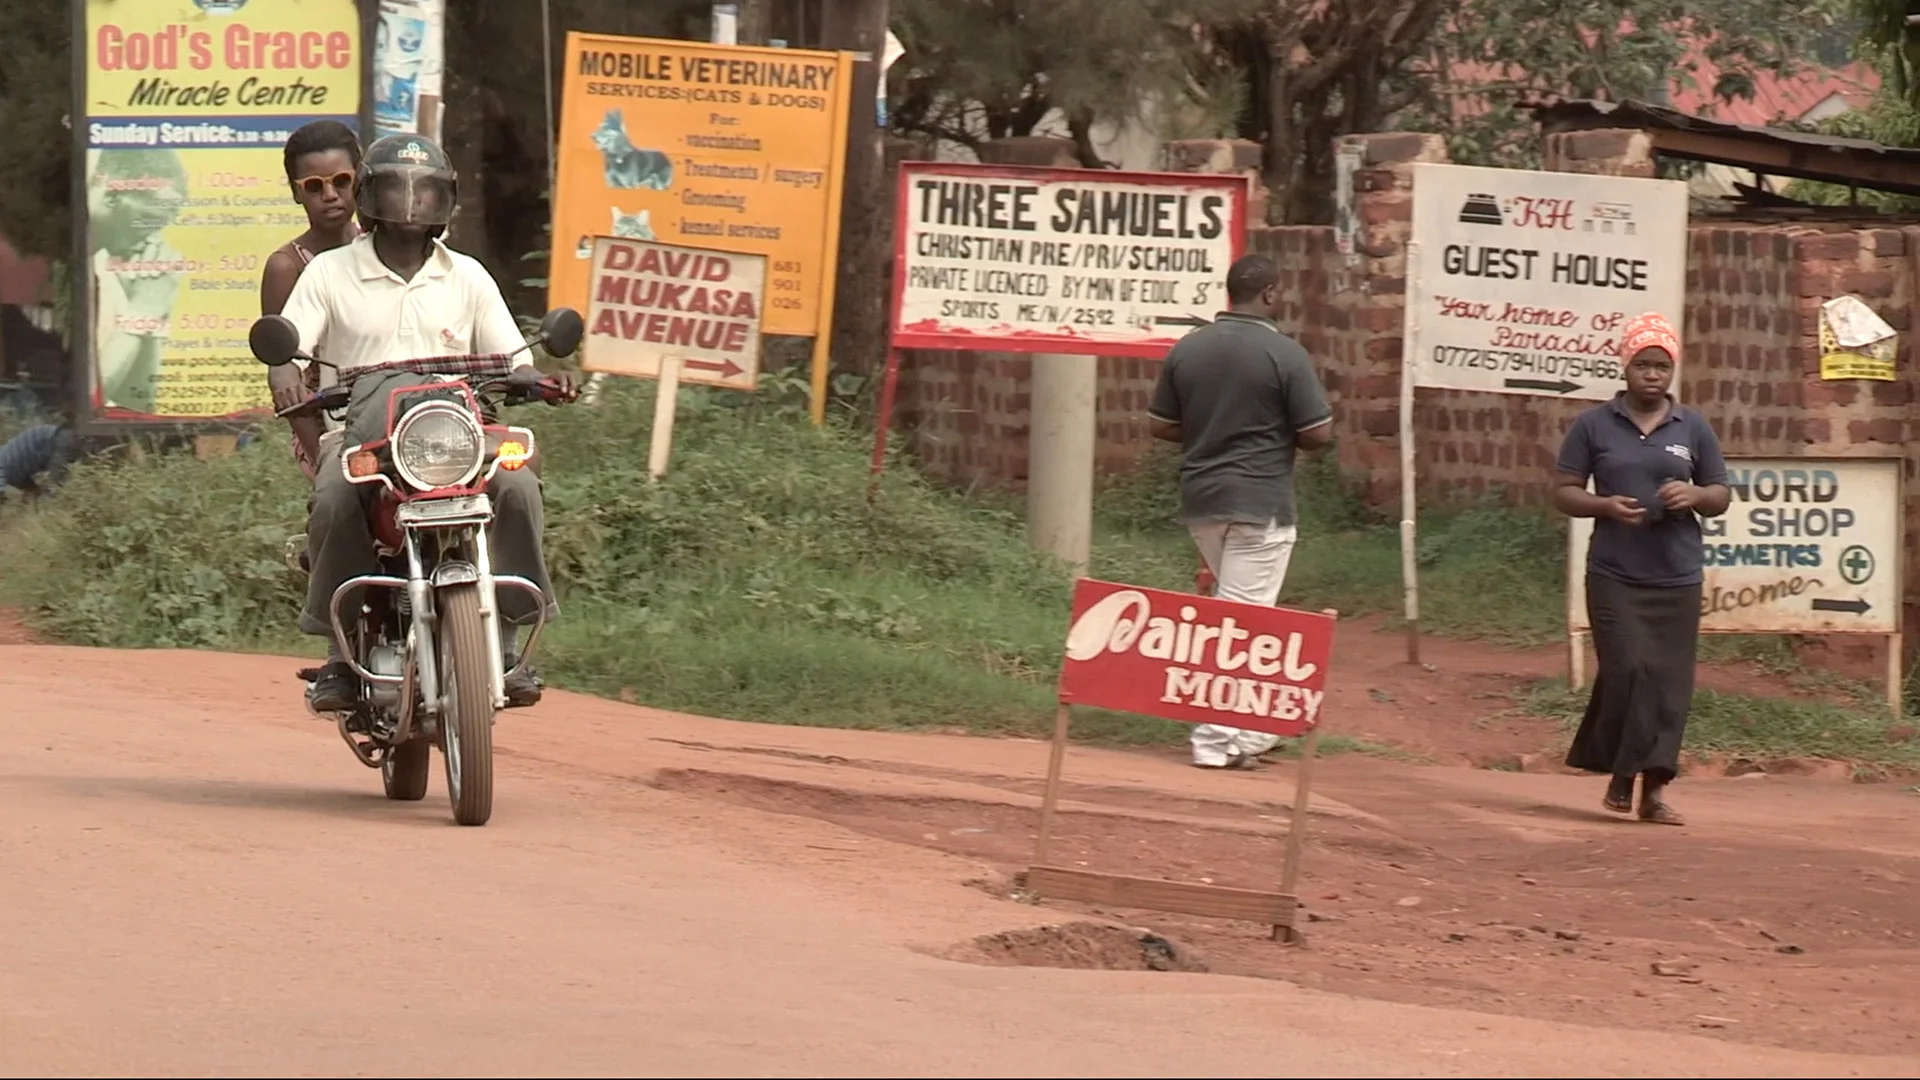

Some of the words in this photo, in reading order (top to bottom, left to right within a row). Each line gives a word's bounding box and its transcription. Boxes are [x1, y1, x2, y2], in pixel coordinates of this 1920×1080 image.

[97, 24, 213, 71] God's
[224, 23, 350, 69] Grace
[580, 51, 671, 81] MOBILE
[681, 56, 835, 92] VETERINARY
[127, 77, 230, 107] Miracle
[236, 77, 329, 106] Centre
[748, 92, 762, 106] &
[768, 93, 826, 112] DOGS)
[89, 122, 158, 146] Sunday
[160, 121, 236, 143] Service:
[709, 113, 741, 125] For:
[685, 159, 758, 180] Treatments
[774, 169, 824, 189] surgery
[682, 188, 746, 213] Grooming
[917, 180, 1040, 231] THREE
[1051, 188, 1224, 239] SAMUELS
[680, 216, 724, 236] kennel
[728, 221, 781, 239] services
[219, 255, 258, 271] 5:00
[916, 232, 1023, 264] CHRISTIAN
[603, 244, 731, 283] DAVID
[773, 260, 802, 273] 681
[1444, 244, 1539, 280] GUEST
[1552, 252, 1648, 291] HOUSE
[189, 278, 219, 291] Bible
[596, 275, 758, 319] MUKASA
[773, 278, 802, 292] 901
[908, 266, 969, 292] PRIVATE
[1062, 275, 1085, 299] BY
[180, 314, 219, 330] 5:00
[941, 300, 999, 320] SPORTS
[1497, 302, 1581, 328] home
[591, 309, 749, 352] AVENUE
[1490, 326, 1621, 357] Paradis
[1747, 507, 1855, 537] SHOP
[1702, 543, 1822, 568] OSMETICS
[1700, 575, 1824, 617] elcome
[1139, 606, 1317, 681] airtel
[1160, 666, 1324, 724] MONEY
